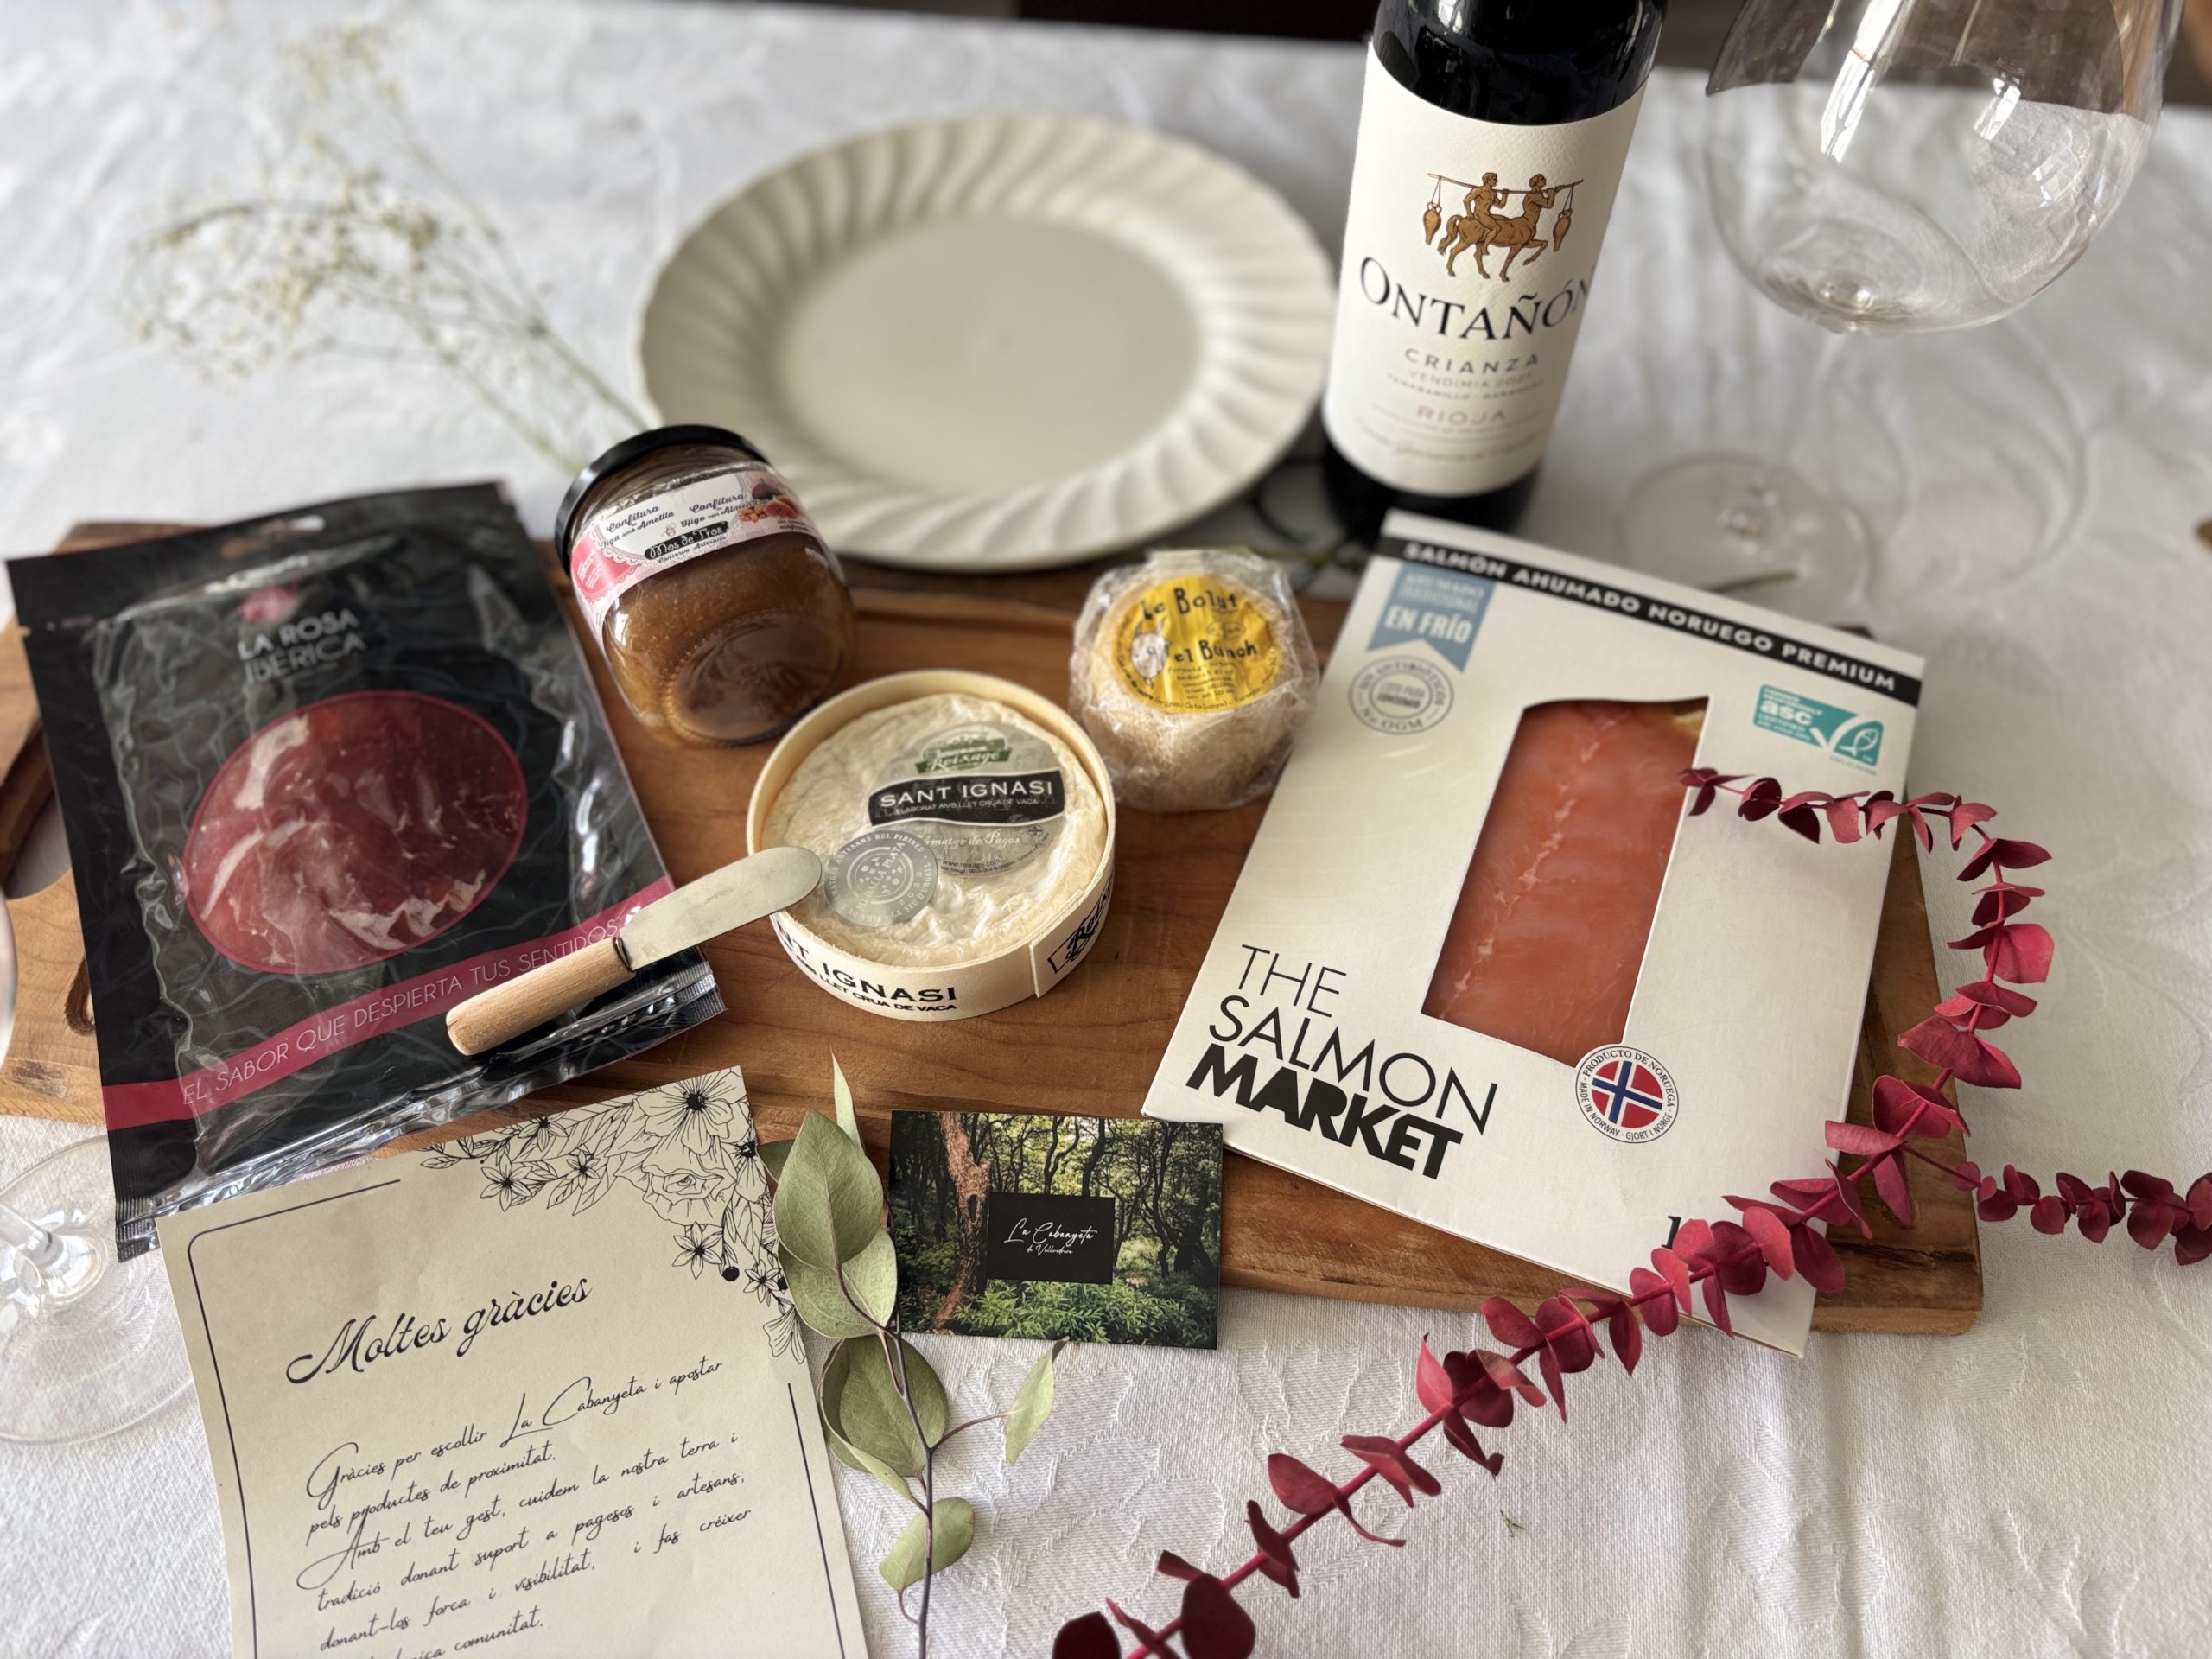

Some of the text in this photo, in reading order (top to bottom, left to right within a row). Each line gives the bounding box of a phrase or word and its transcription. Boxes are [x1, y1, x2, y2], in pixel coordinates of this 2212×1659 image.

[1405, 347, 1538, 374] CRIANZA
[1417, 404, 1505, 425] RIOJA
[606, 505, 660, 533] Confitura
[689, 493, 747, 513] Confitura
[650, 526, 723, 558] Mos de Tros
[238, 608, 359, 660] LA ROSA
[1384, 605, 1473, 644] EN FRÍO
[1512, 568, 1641, 614] AHUMADO
[1648, 603, 1774, 654] NORUEGO
[1781, 639, 1897, 692] PREMIUM
[1760, 700, 1813, 726] asc
[880, 780, 1052, 807] SANT IGNASI
[894, 804, 936, 816] ELABORAT
[836, 836, 872, 864] ARTESANS
[893, 833, 925, 853] PIRINEU
[882, 842, 906, 868] PLATA
[904, 899, 919, 912] SEU
[820, 974, 849, 994] LLET
[852, 992, 890, 1007] CRUA
[894, 1003, 914, 1012] DE
[823, 962, 957, 1002] IGNASI
[1239, 944, 1347, 1018] THE
[183, 918, 620, 1105] EL SABOR QUE DESPIERTA TUS SENTIDOS
[1208, 995, 1498, 1135] SALMON
[1582, 1050, 1675, 1107] PRODUCTO DE NORUEGA
[1185, 1042, 1463, 1180] MARKET
[1579, 1081, 1621, 1136] MADE IN NORWAY
[1625, 1131, 1649, 1141] GJORT
[1652, 1112, 1673, 1134] NORGE
[1003, 1217, 1098, 1247] La Cabanyeta
[286, 1278, 593, 1384] Moltes gràcies
[307, 1355, 723, 1510] Gràcies per escollir La Cabanyeta i apostar
[296, 1432, 738, 1590] Amb el teu gest, cuidem la nostra terra i
[306, 1440, 556, 1547] pels productes de proximitat.
[317, 1472, 745, 1611] tradició donant suport a pagesos i artesans,
[320, 1607, 411, 1651] donant-los
[488, 1588, 496, 1599] i
[515, 1548, 595, 1592] visibilitat,
[634, 1541, 641, 1554] i
[652, 1523, 681, 1554] fas
[699, 1510, 752, 1532] créixer
[454, 1605, 543, 1651] comunitat.
